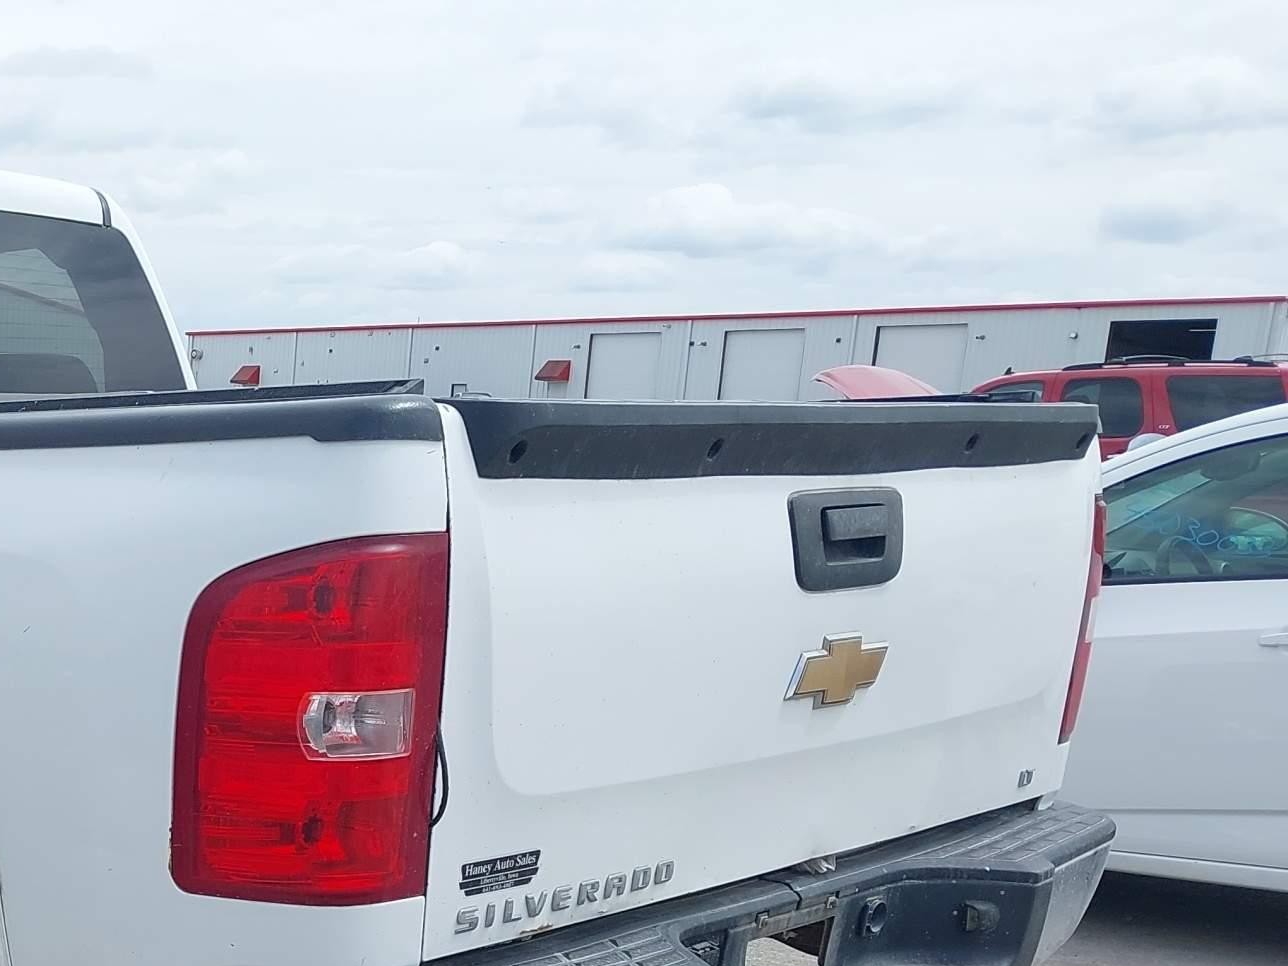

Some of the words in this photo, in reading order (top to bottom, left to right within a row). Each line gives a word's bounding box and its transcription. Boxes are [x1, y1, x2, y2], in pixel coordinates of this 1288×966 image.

[465, 863, 493, 876] Haney
[494, 859, 514, 872] Auto
[515, 853, 537, 867] Sales
[454, 860, 675, 934] SILVERADO
